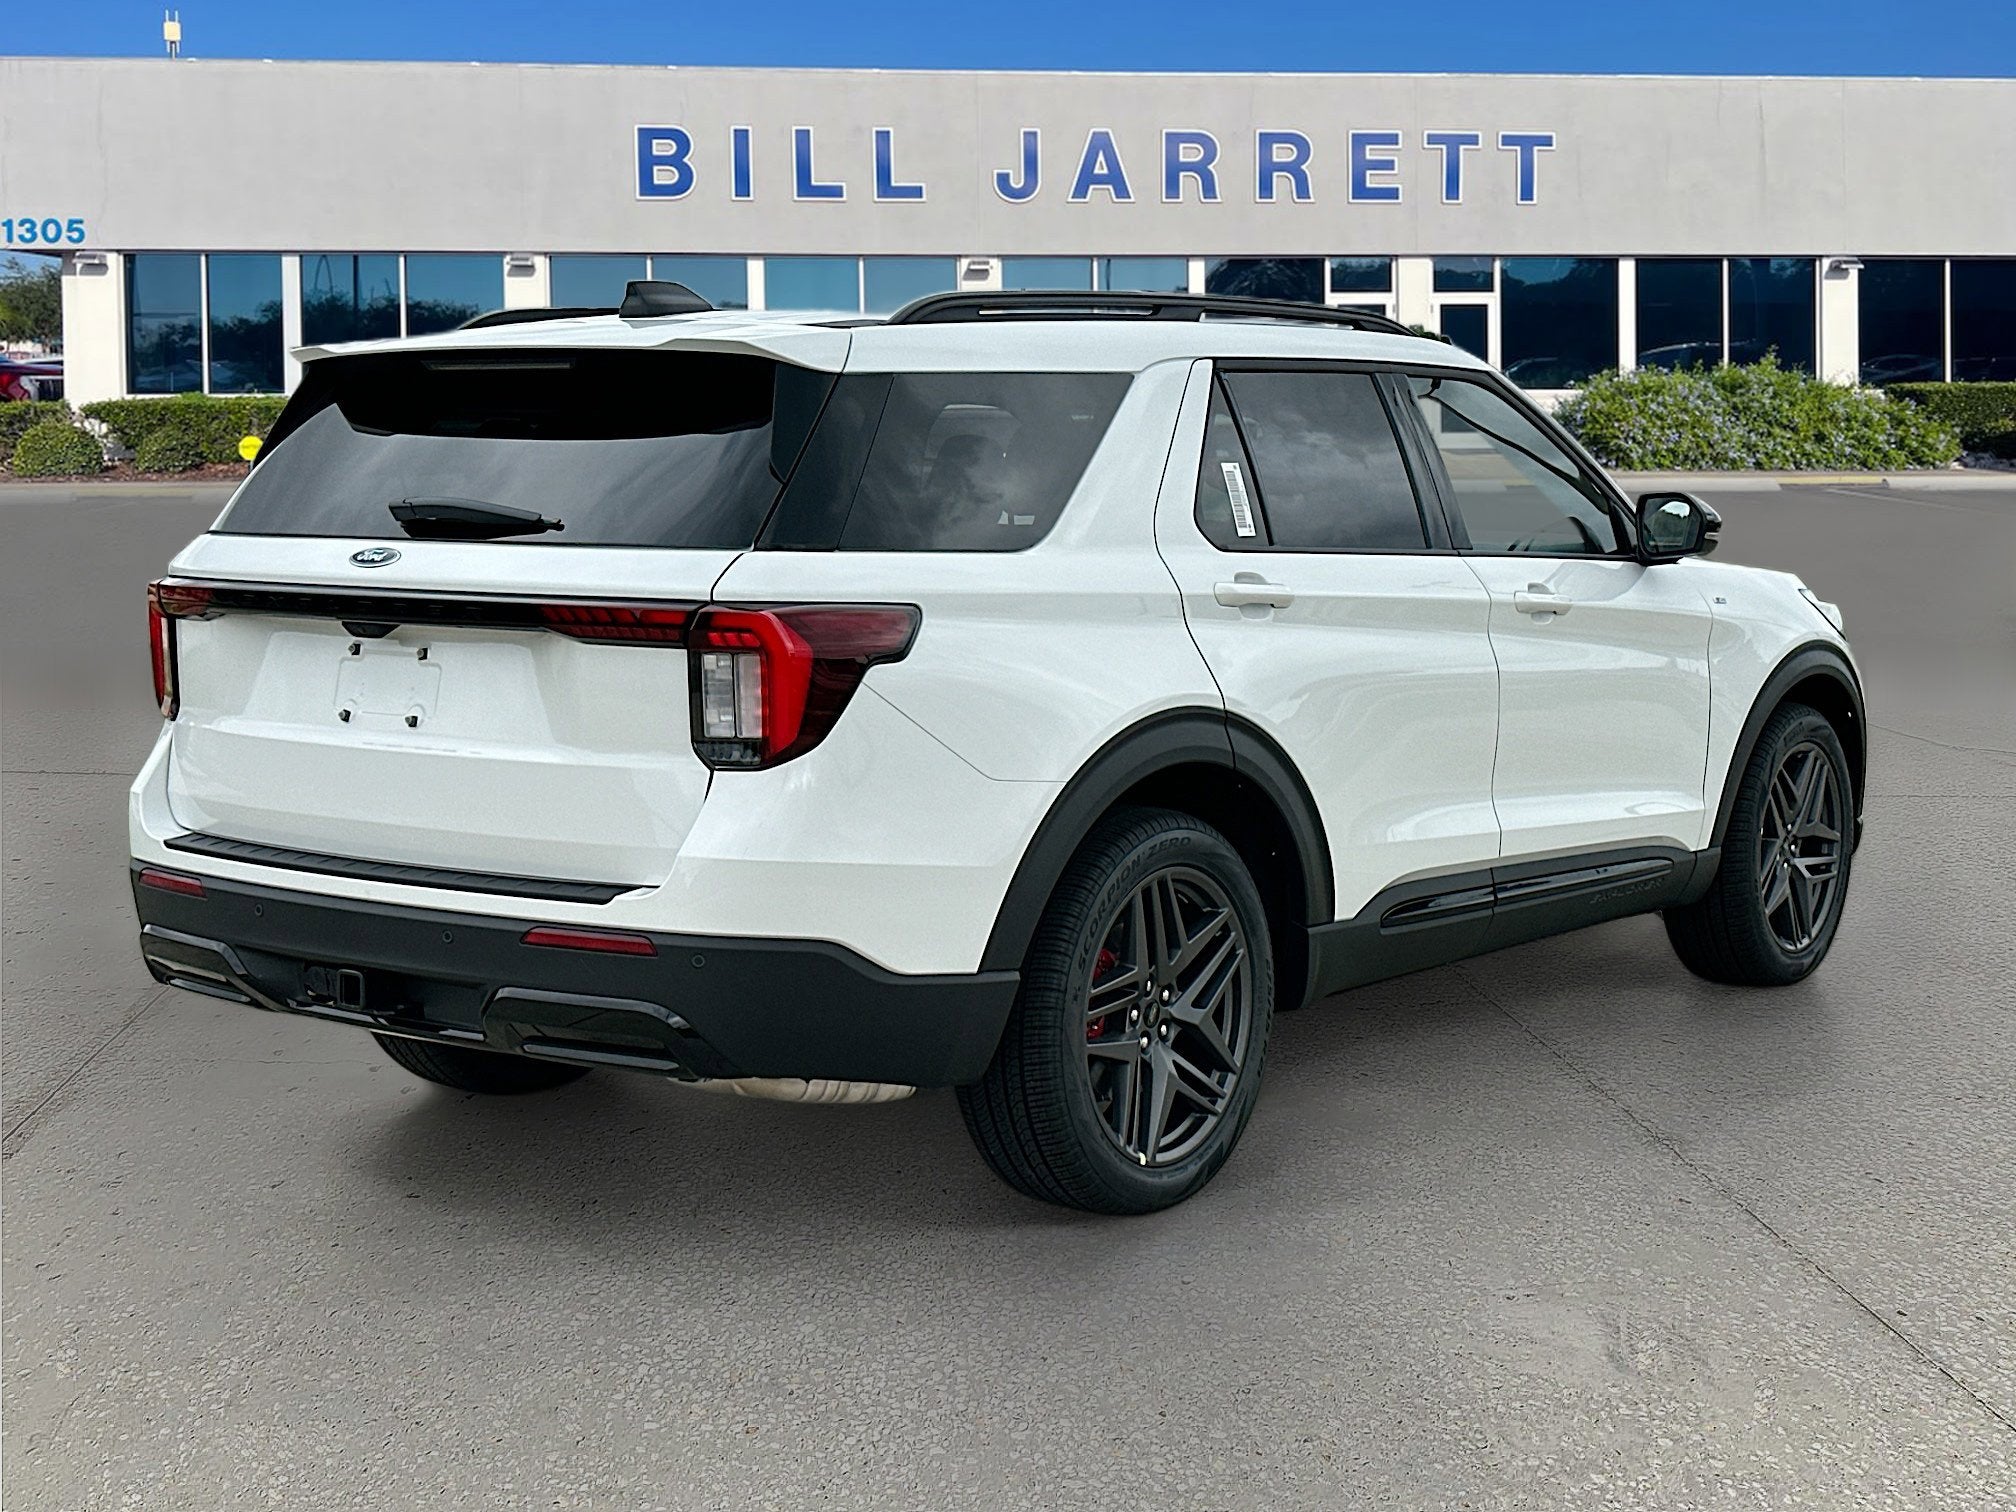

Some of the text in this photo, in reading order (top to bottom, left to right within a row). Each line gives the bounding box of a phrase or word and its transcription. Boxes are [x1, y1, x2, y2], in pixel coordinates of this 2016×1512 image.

[635, 124, 1557, 206] BILL JARRETT
[1, 217, 86, 244] 1305
[1078, 836, 1192, 974] SCORPION ZERO
